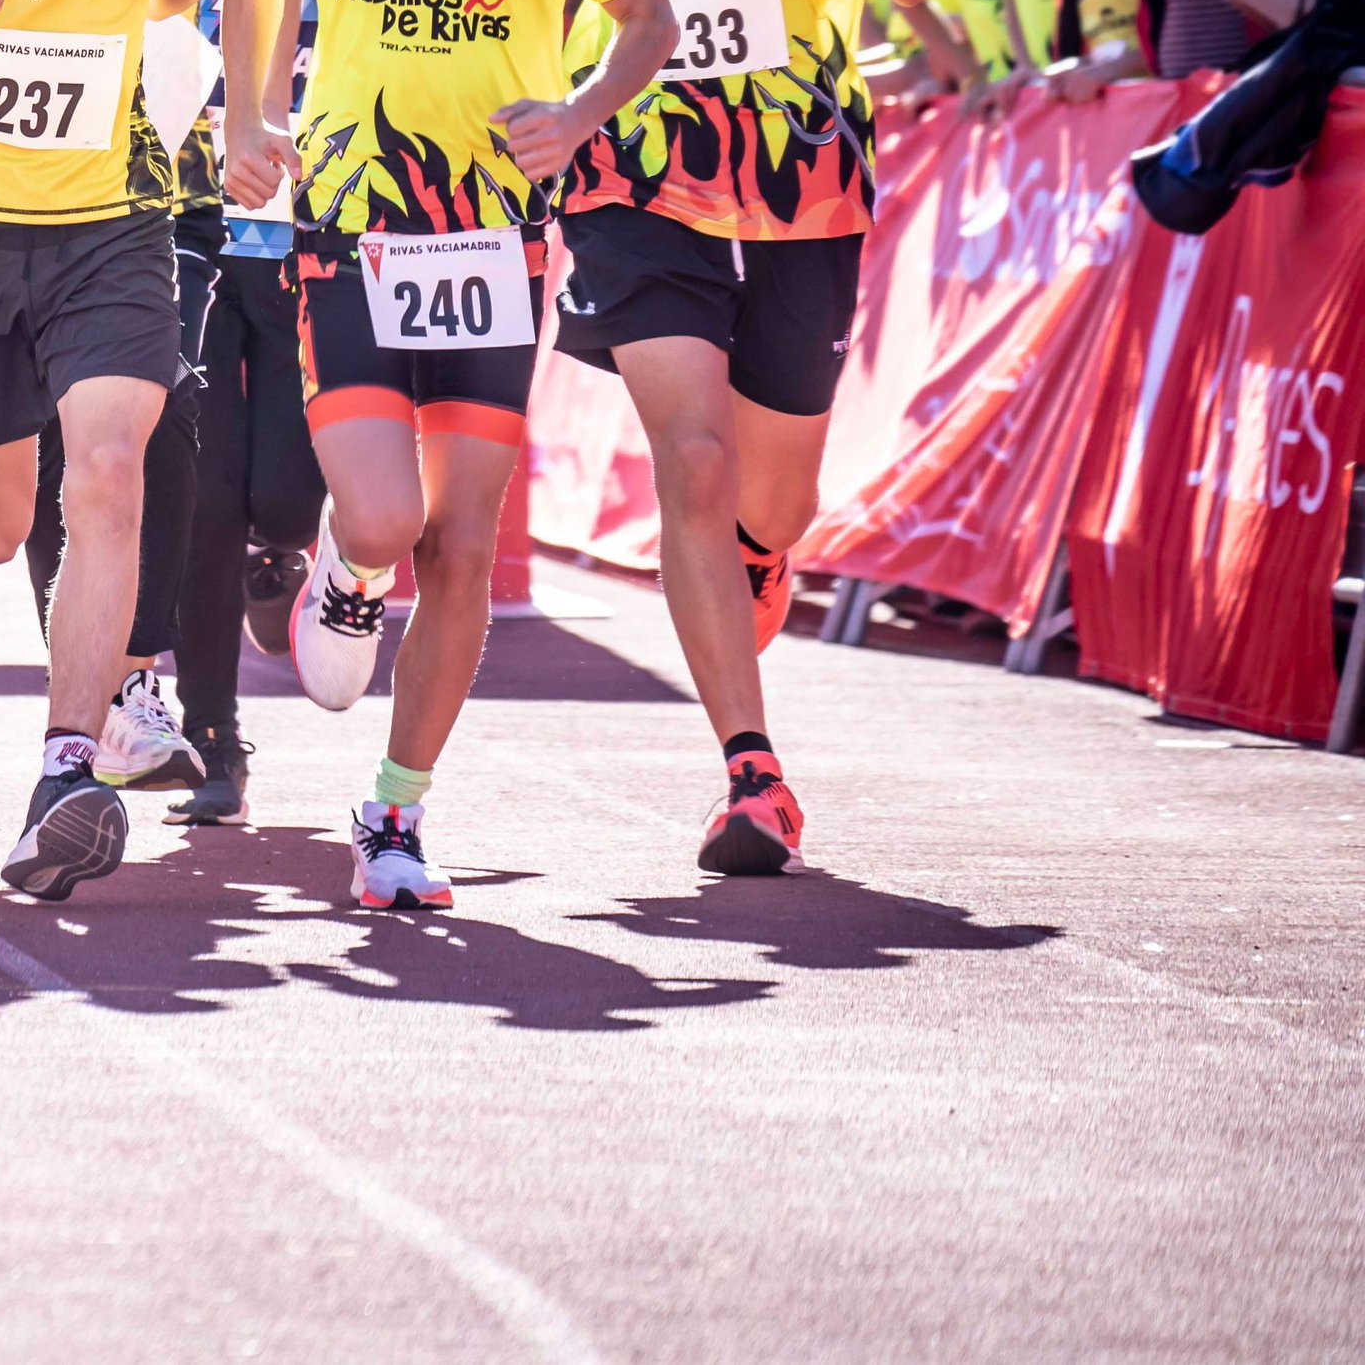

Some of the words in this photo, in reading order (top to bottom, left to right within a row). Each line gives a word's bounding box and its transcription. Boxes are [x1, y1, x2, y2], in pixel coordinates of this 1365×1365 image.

[661, 8, 749, 70] 33
[34, 47, 105, 59] VACIAMADRID
[379, 42, 452, 55] TRIATLON
[389, 244, 423, 257] RIVAS
[426, 241, 502, 254] VACIAMADRID
[394, 275, 493, 338] 240
